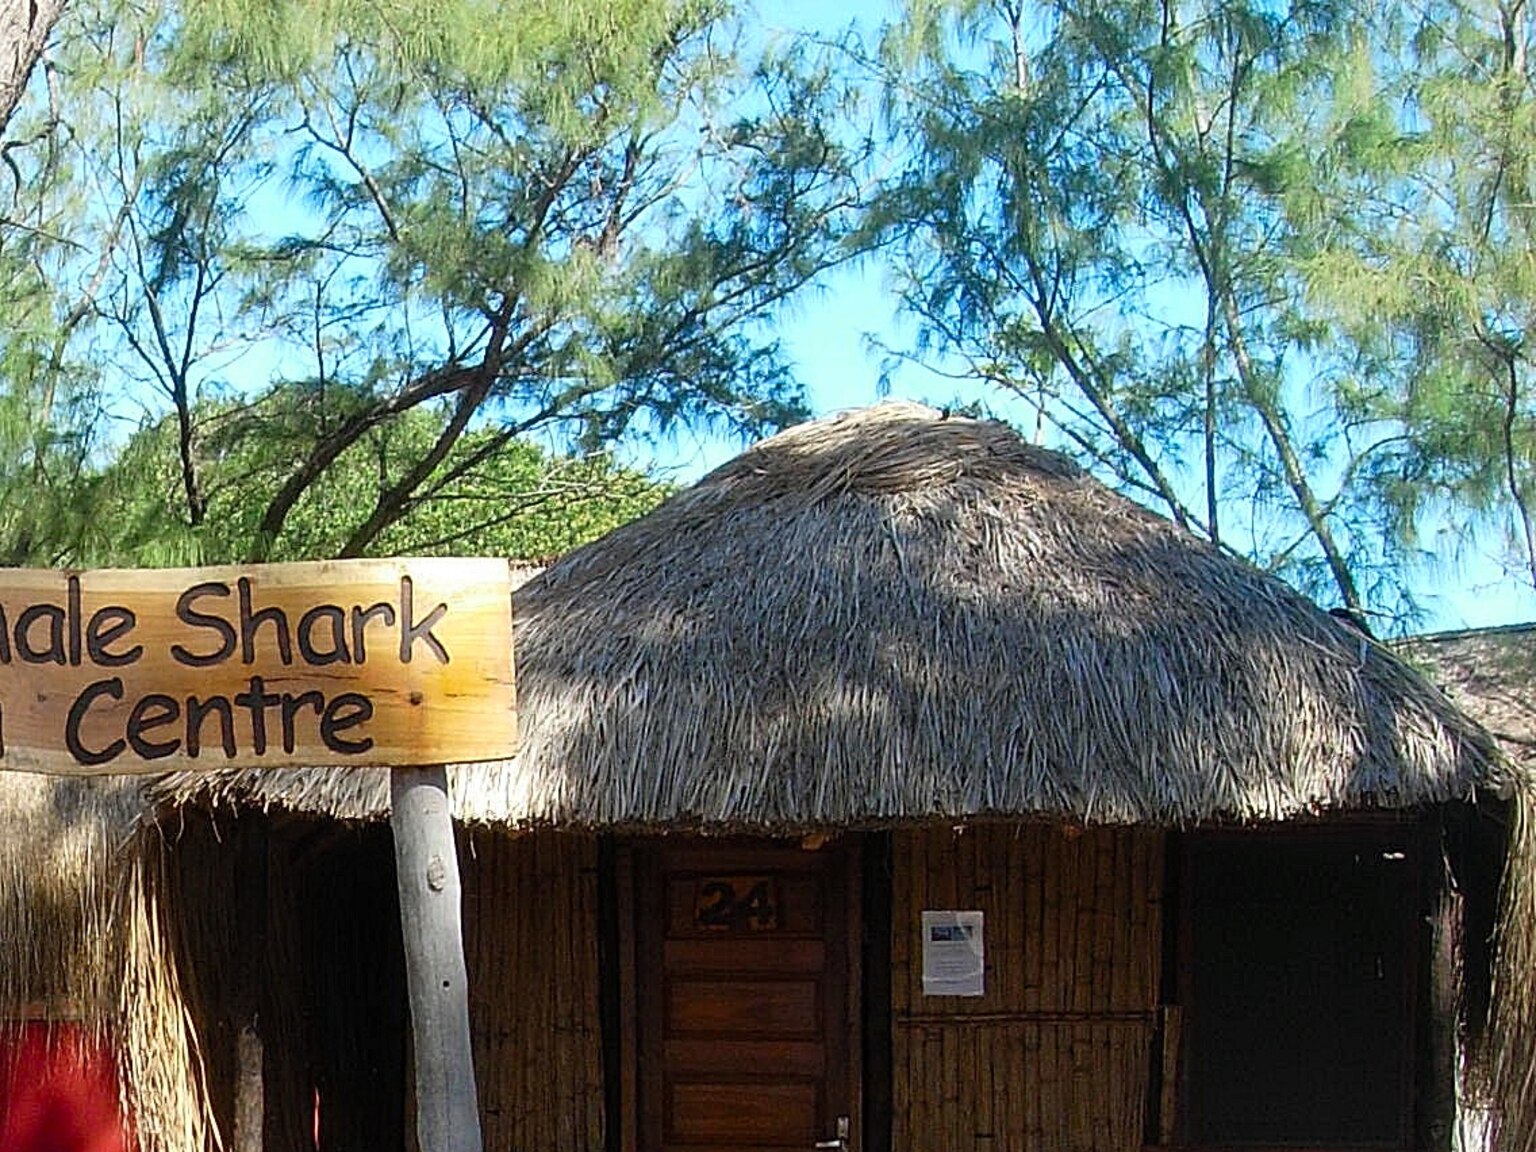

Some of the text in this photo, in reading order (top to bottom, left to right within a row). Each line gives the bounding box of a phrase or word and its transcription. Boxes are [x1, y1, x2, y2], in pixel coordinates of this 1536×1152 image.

[171, 576, 450, 667] Shark
[64, 676, 374, 765] Centre
[699, 881, 775, 927] 24
